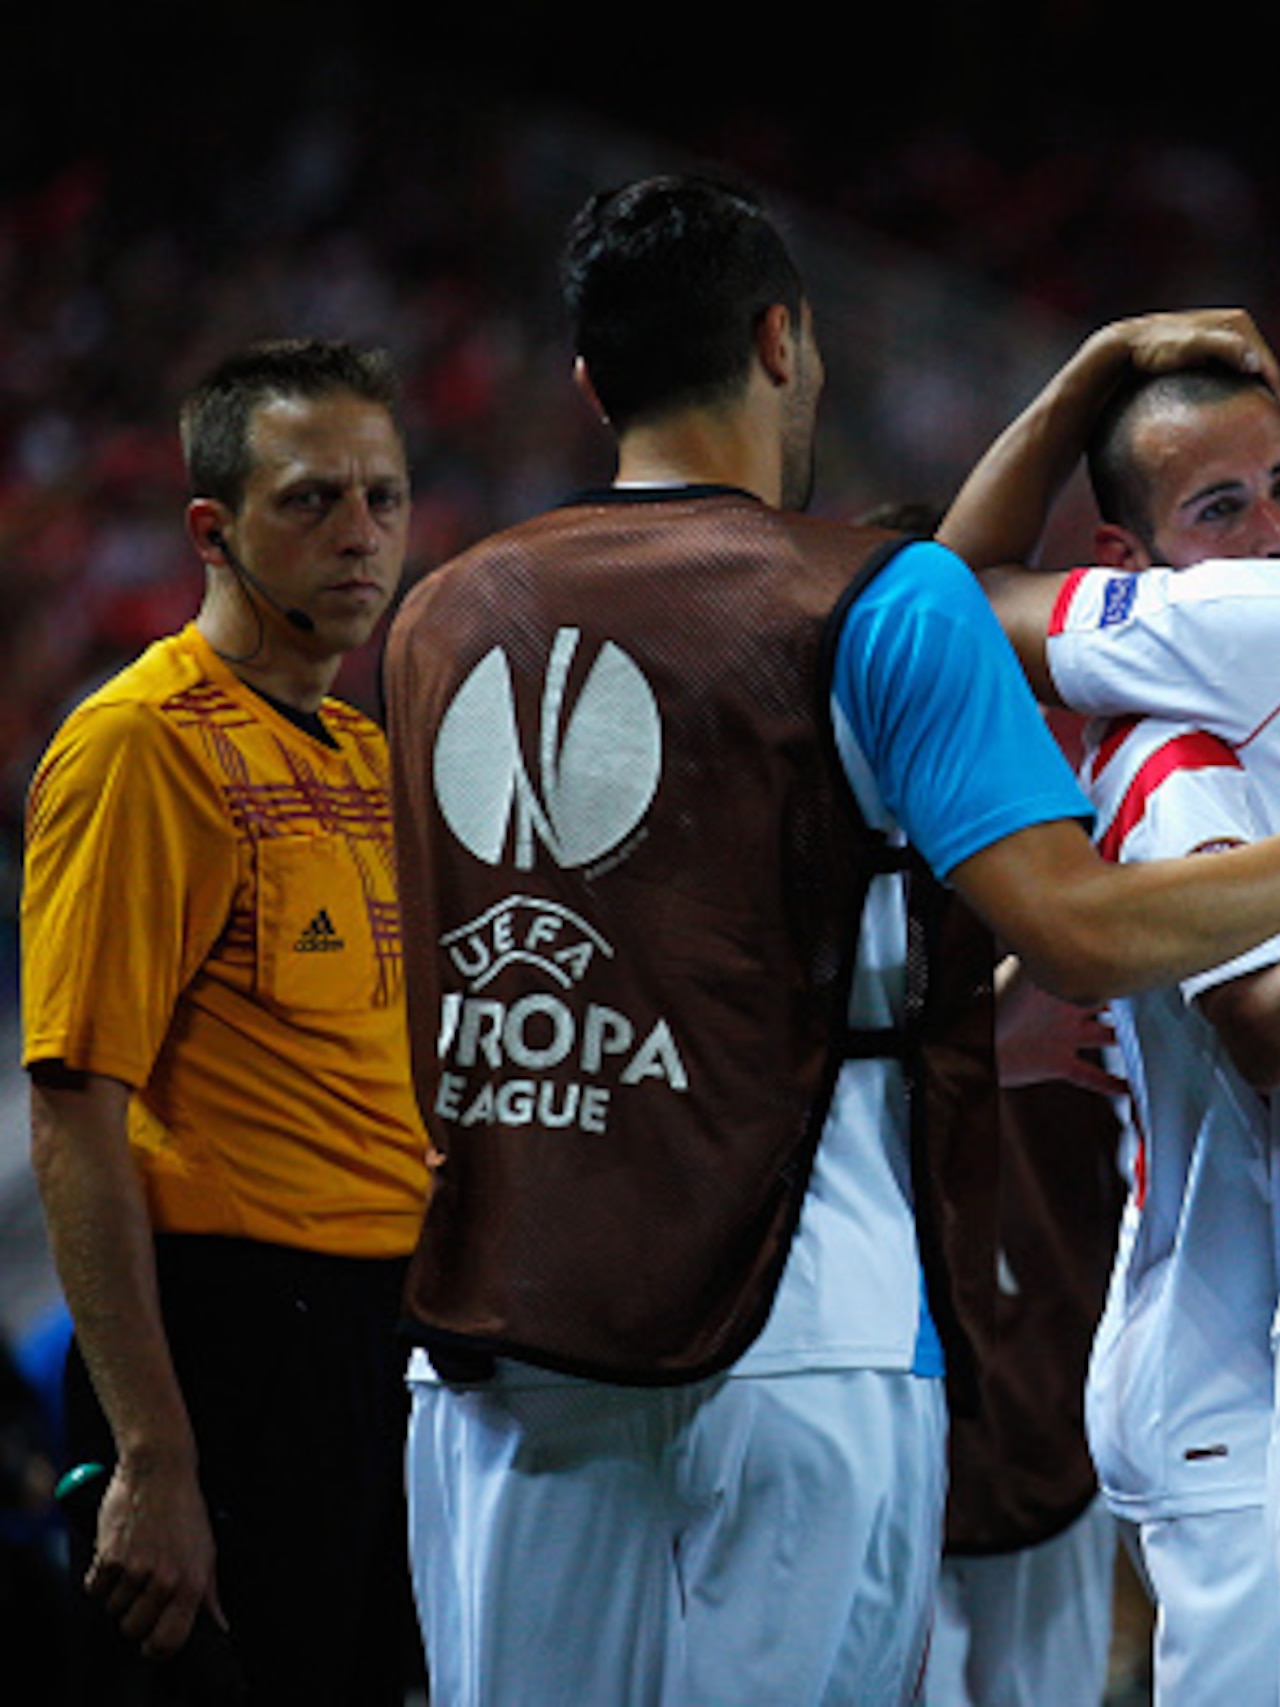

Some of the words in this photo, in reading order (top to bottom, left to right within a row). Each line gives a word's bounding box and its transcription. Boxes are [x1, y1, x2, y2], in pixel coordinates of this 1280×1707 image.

[450, 910, 594, 980] UEFA
[437, 992, 690, 1092] ROPA
[433, 1071, 612, 1134] EAGUE
